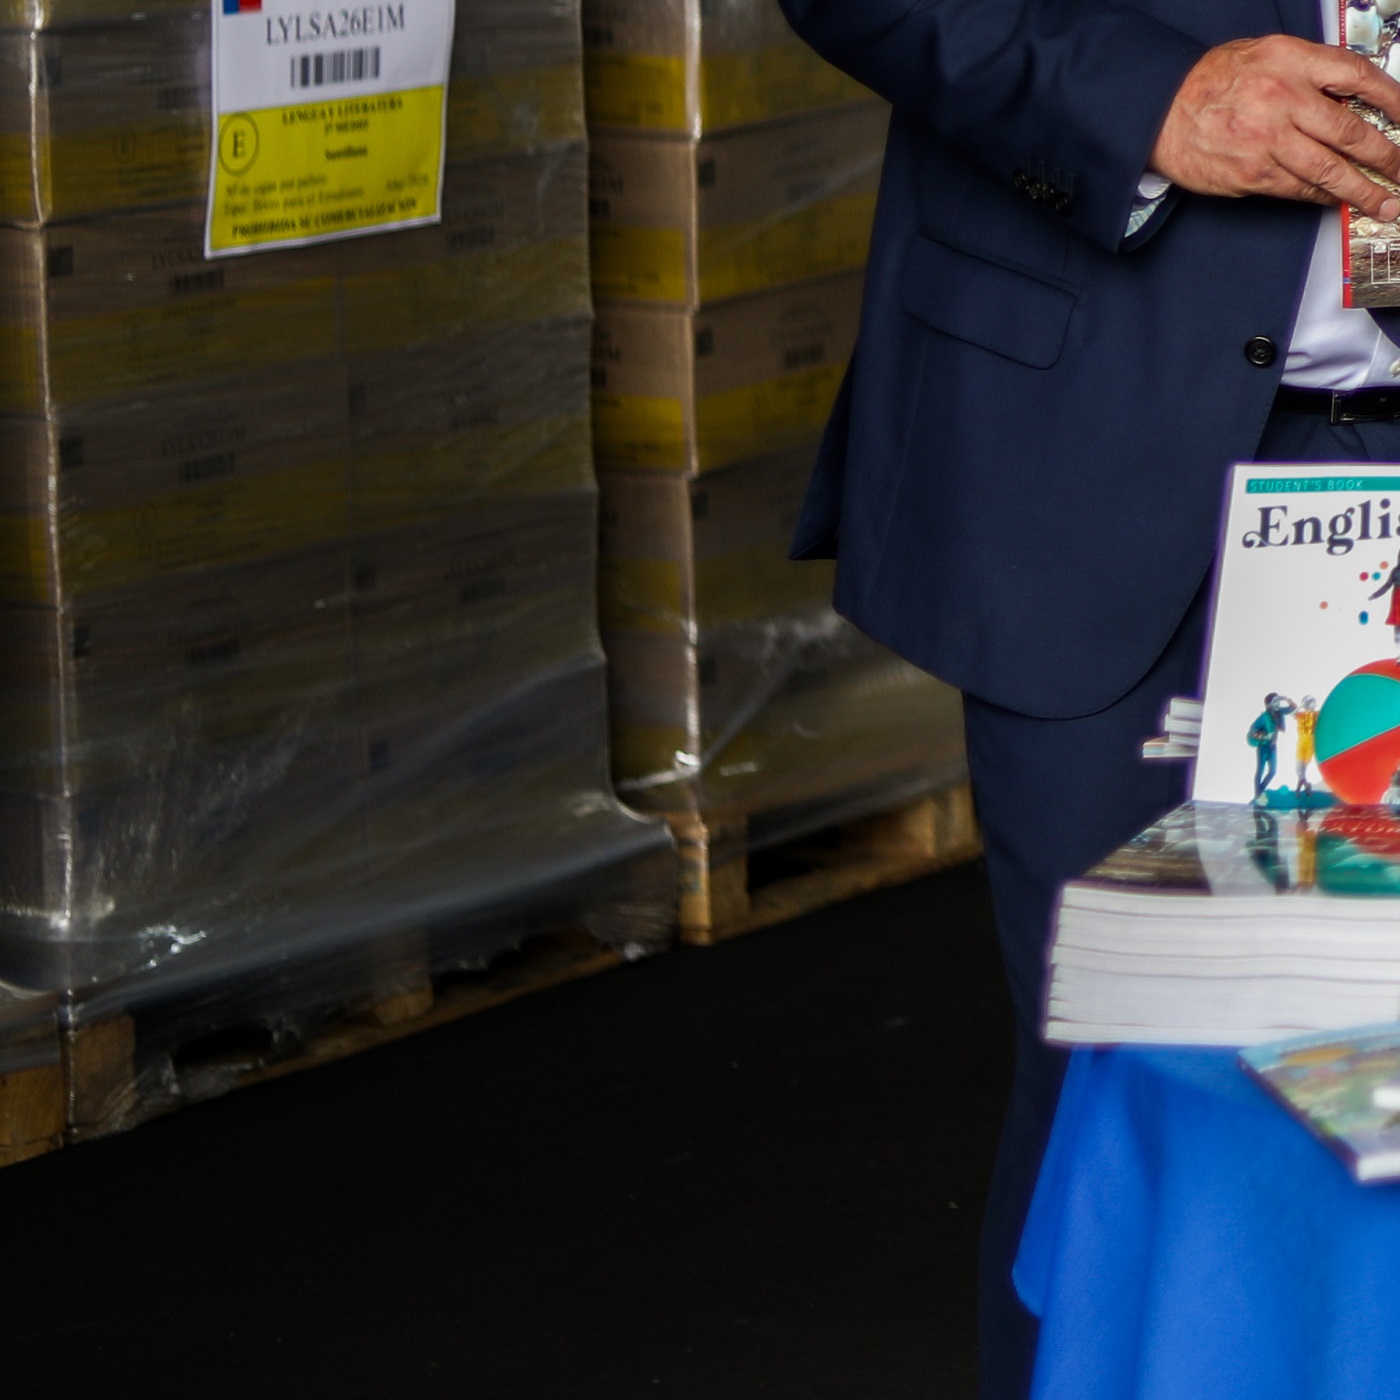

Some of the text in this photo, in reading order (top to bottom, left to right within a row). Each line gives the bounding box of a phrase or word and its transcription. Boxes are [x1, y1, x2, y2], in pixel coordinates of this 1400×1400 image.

[265, 3, 405, 46] LYLSA26E1M
[232, 130, 246, 159] E
[1250, 478, 1363, 492] STUDENT'S BOOK
